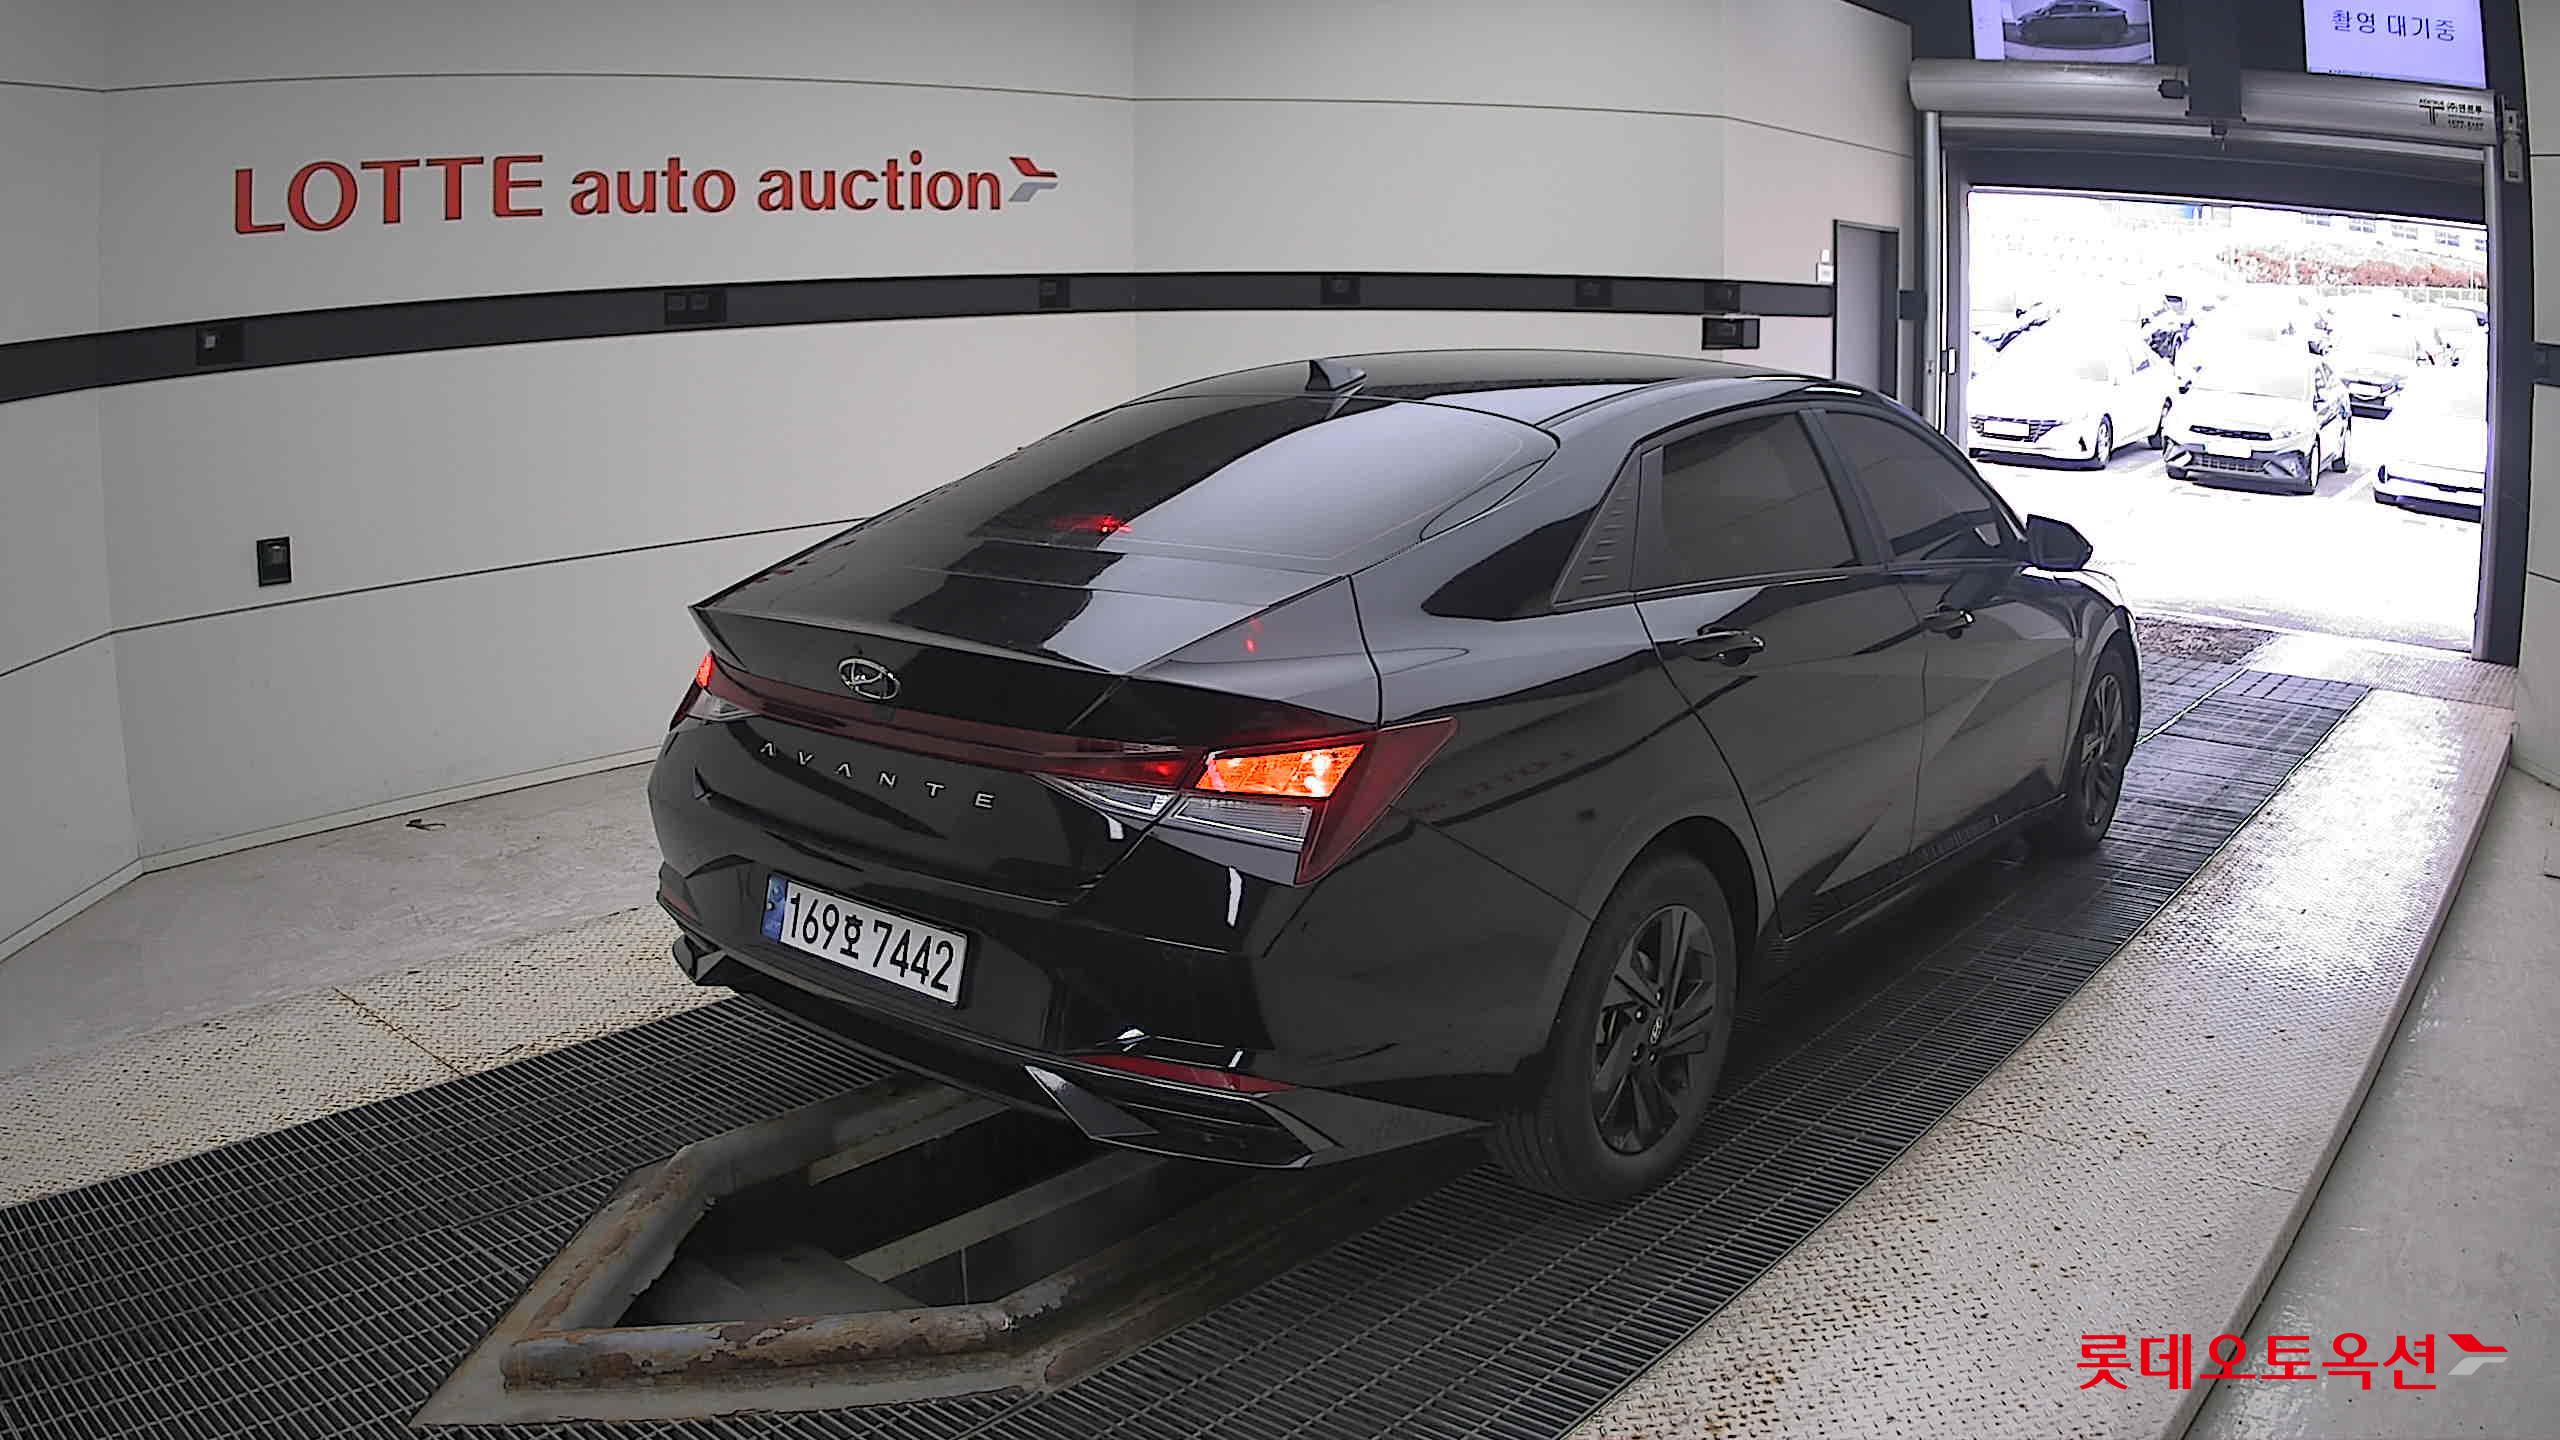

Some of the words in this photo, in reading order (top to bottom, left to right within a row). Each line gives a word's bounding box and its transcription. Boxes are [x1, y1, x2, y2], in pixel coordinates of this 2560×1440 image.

[2332, 9, 2377, 34] 촬영
[2387, 15, 2456, 42] 대기중
[235, 156, 542, 233] LOTTE
[570, 158, 736, 215] auto
[758, 150, 1001, 211] auction
[760, 741, 997, 810] AVANTE
[789, 891, 864, 961] 169호
[872, 919, 955, 994] 7442
